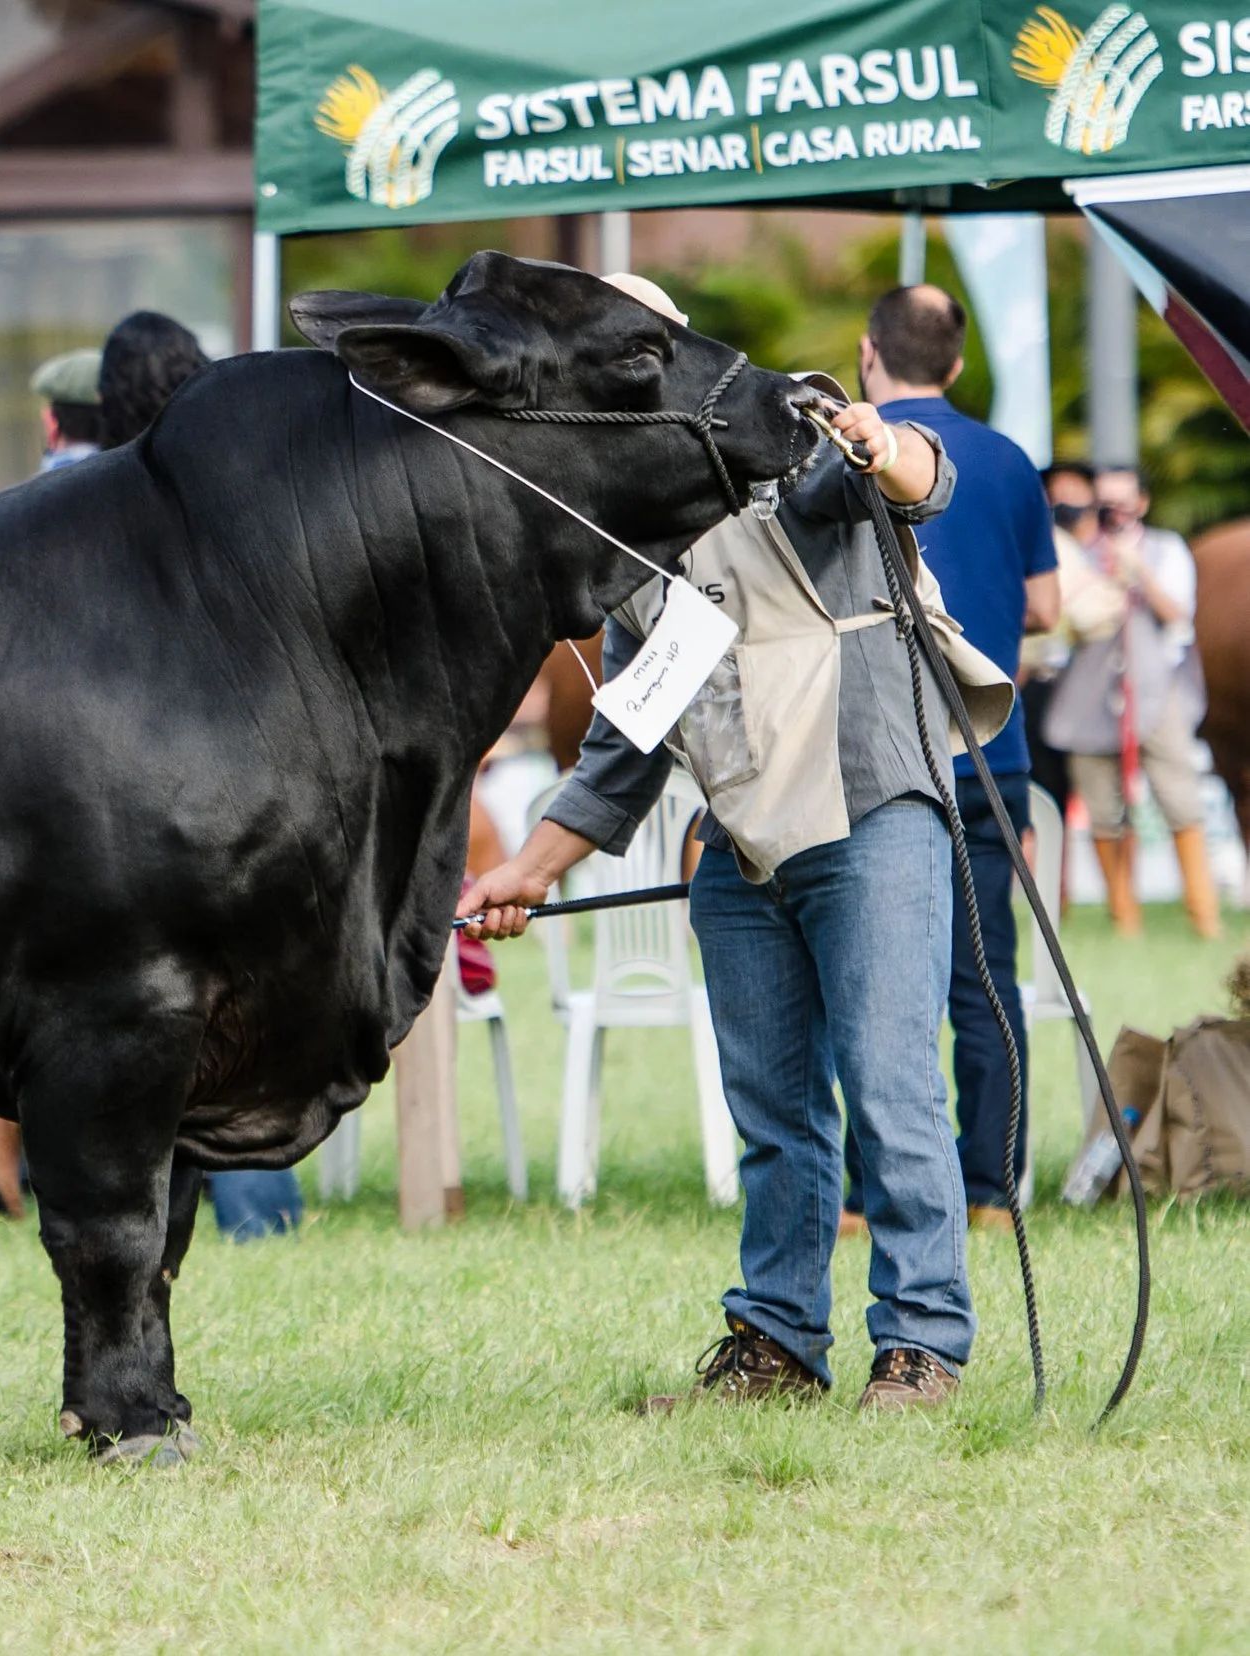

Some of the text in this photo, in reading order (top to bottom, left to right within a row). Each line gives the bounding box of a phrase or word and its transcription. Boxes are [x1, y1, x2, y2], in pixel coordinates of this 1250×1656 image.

[477, 45, 976, 138] SISTEMA FARSUL
[1181, 91, 1250, 132] FAR
[485, 117, 981, 186] FARSUL SENAR CASA RURAL
